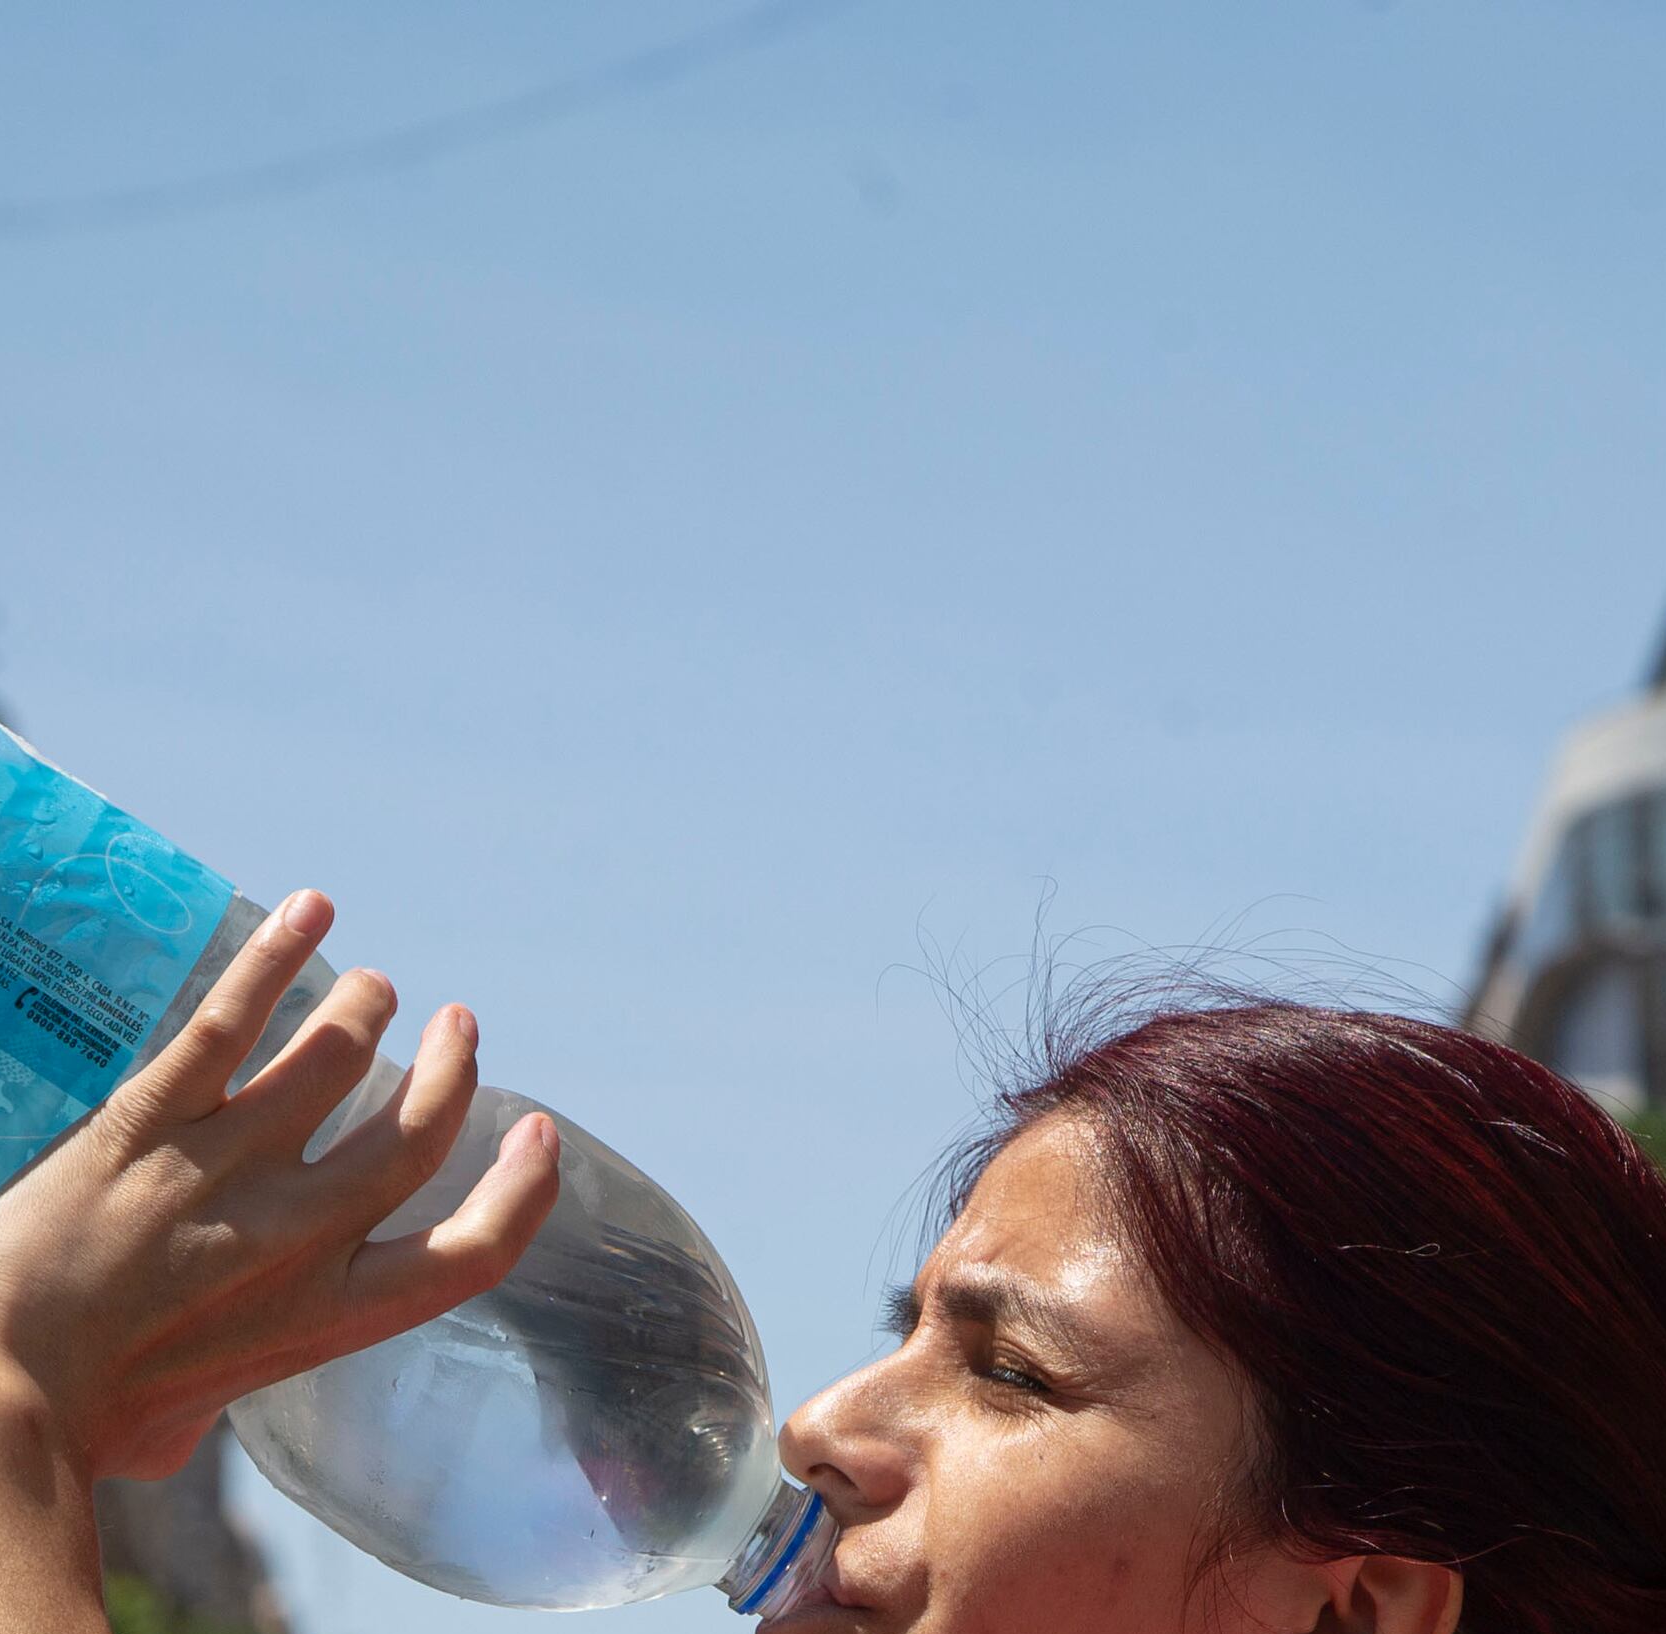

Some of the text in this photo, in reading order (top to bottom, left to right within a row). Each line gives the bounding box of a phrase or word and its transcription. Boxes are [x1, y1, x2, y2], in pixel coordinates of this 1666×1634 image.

[13, 926, 48, 954] MORENO
[63, 960, 84, 978] PISO
[2, 964, 21, 981] VEZ
[0, 947, 27, 969] LUGAR
[50, 981, 80, 1006] FRESCO
[76, 999, 86, 1009] Y
[83, 1003, 104, 1022] SECO
[101, 1016, 124, 1036] CADA
[120, 1029, 138, 1045] VEZ
[61, 1020, 72, 1031] AL
[69, 1012, 84, 1026] DEL
[109, 1040, 121, 1052] DE
[96, 998, 145, 1035] MINERALES:
[25, 1008, 108, 1069] 0800-888-7640
